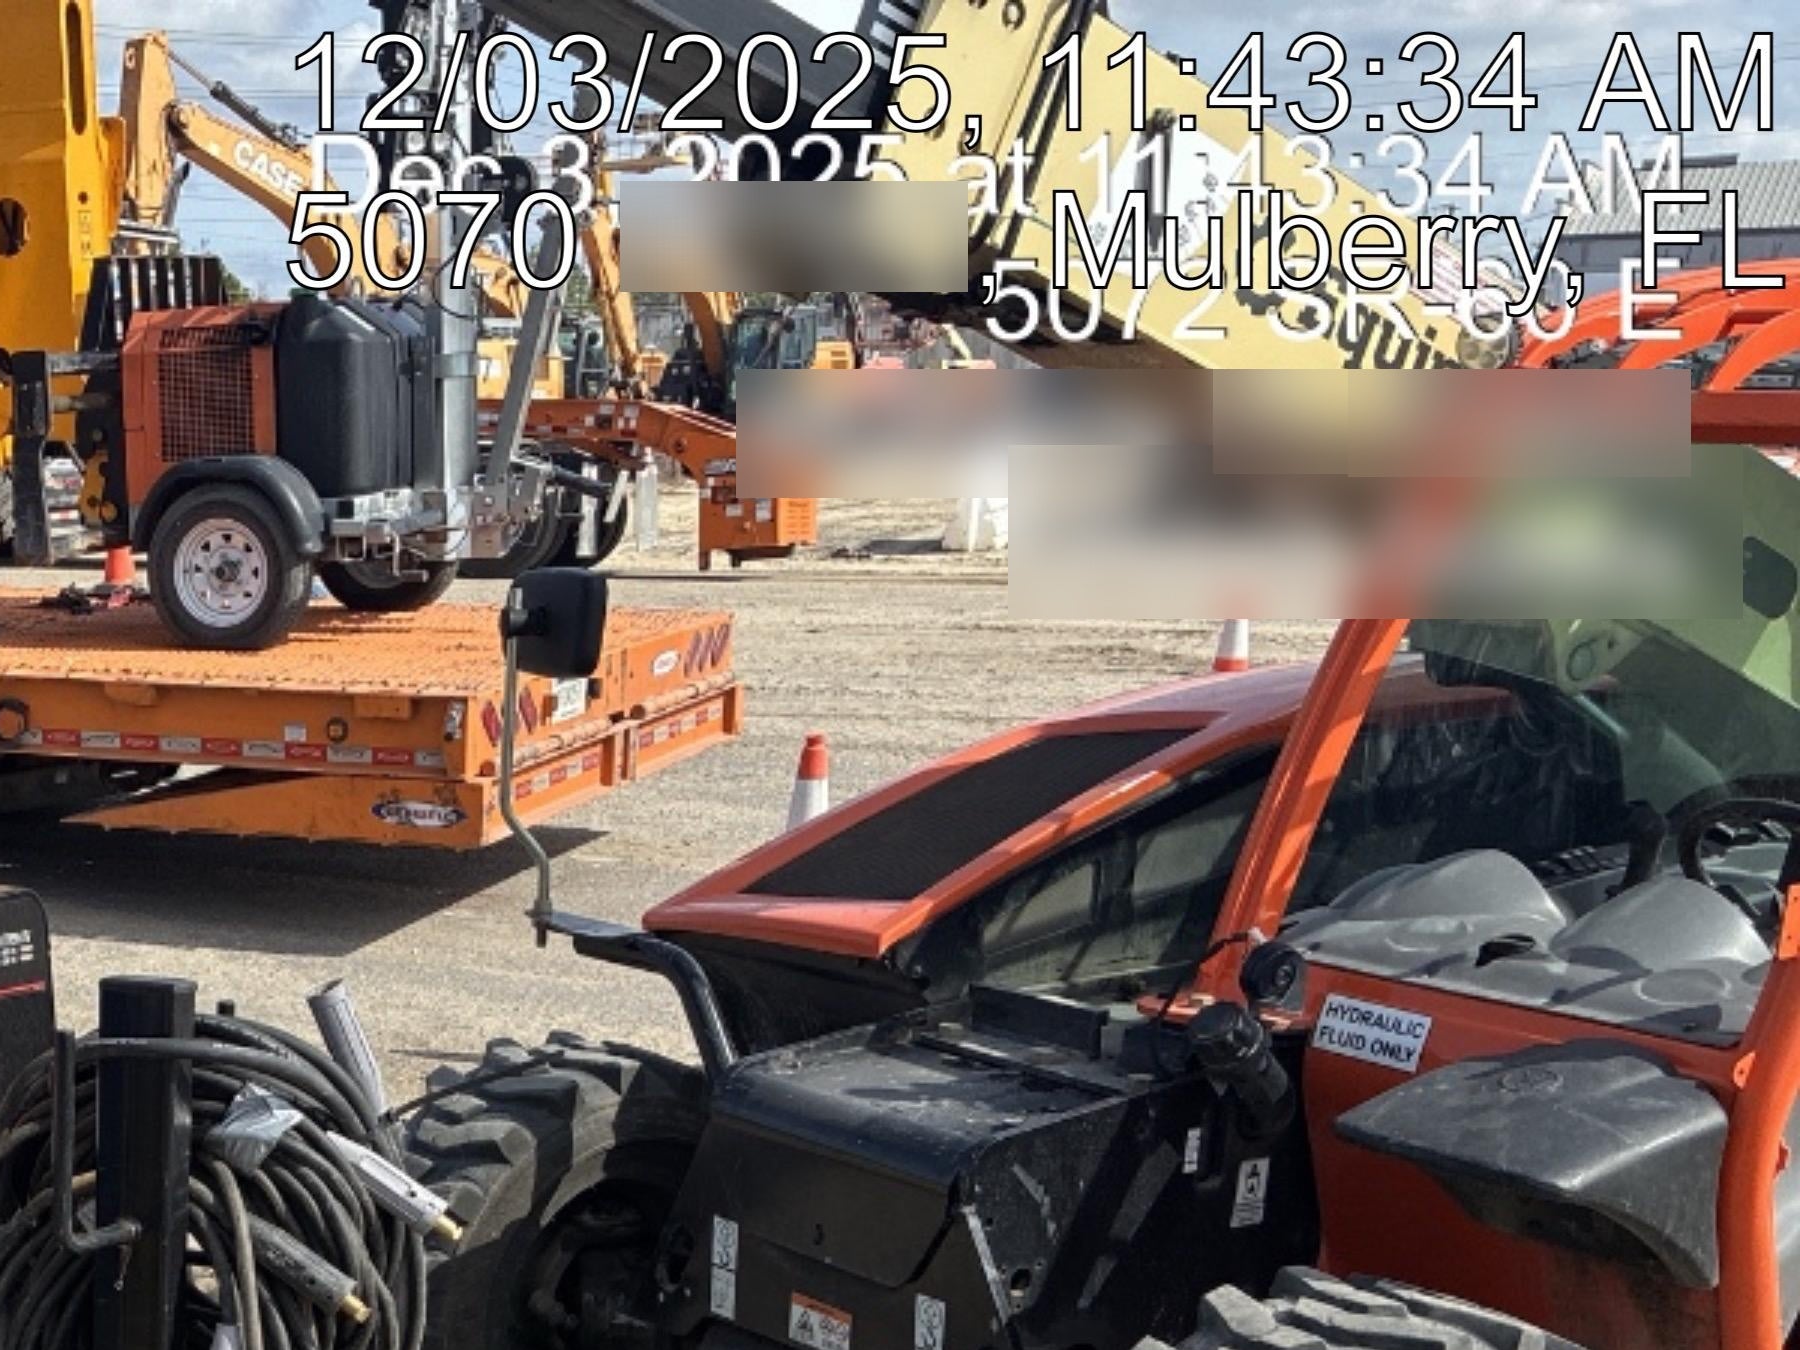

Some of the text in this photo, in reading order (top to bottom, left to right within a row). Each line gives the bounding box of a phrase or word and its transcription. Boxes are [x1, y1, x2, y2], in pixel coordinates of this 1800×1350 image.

[234, 140, 305, 194] CASE
[1325, 1001, 1426, 1039] HYDRAULIC
[1320, 1025, 1418, 1063] FLUID ONLY
